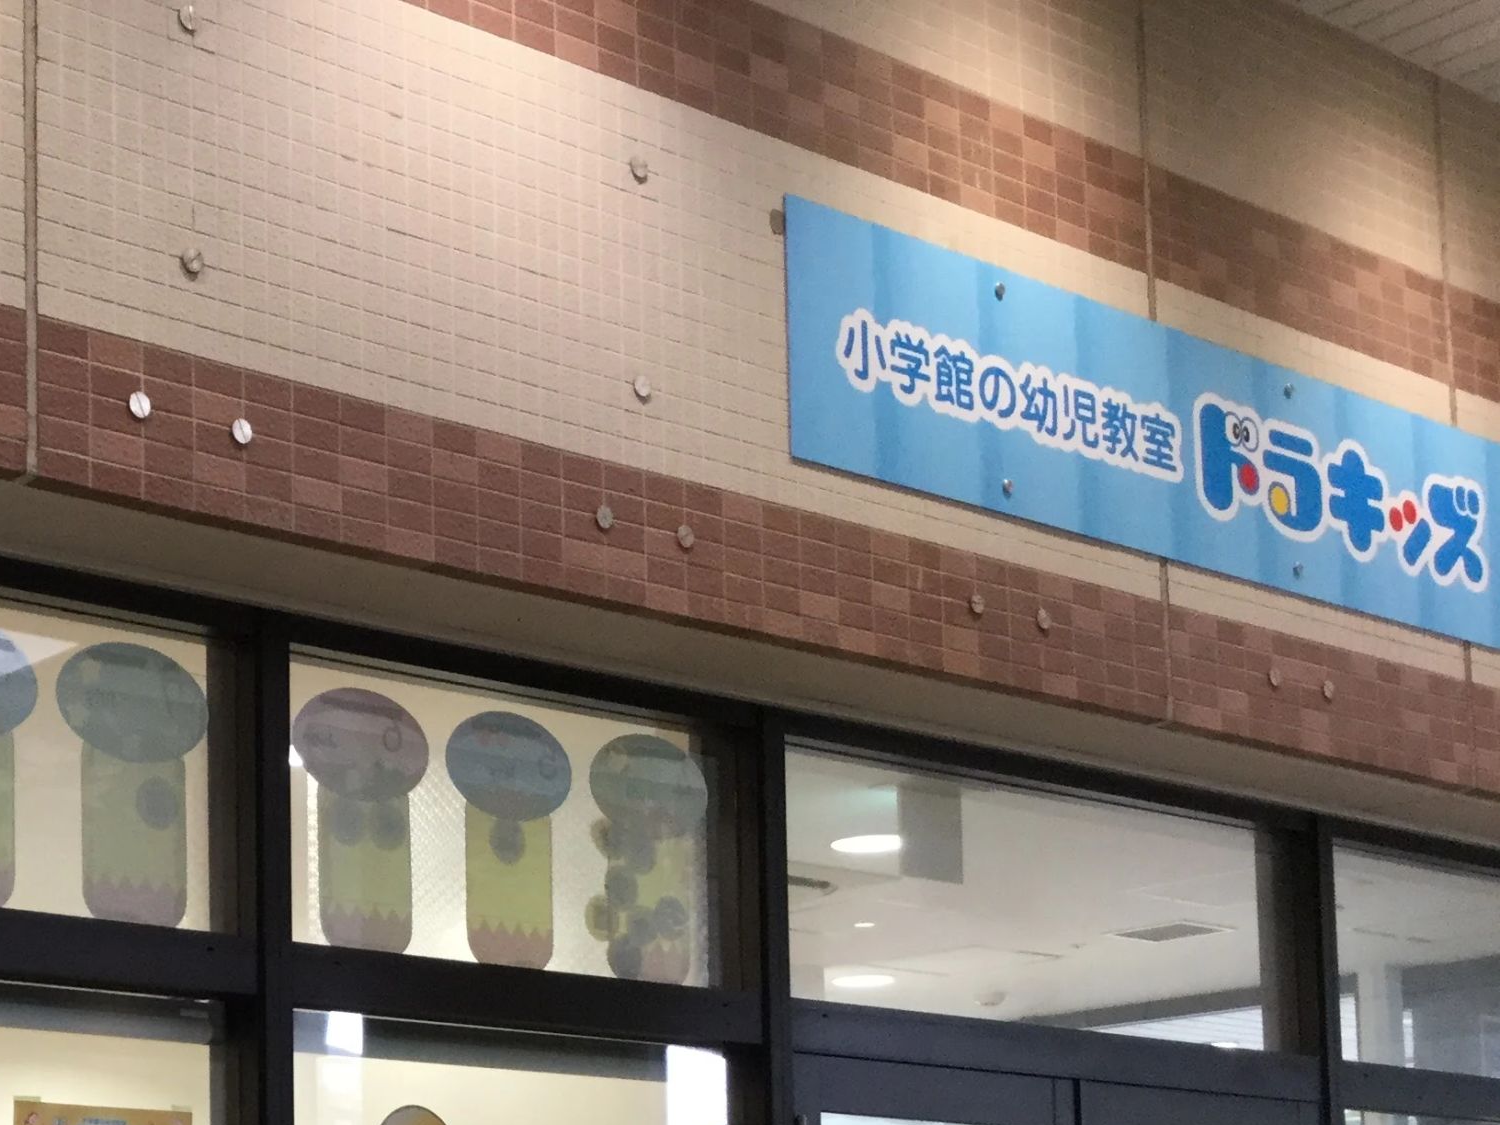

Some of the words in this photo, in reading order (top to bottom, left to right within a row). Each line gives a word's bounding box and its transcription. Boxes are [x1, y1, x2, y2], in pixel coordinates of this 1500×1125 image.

[843, 317, 1179, 474] 小学館の幼児教室
[1199, 400, 1485, 586] ドラキッズ
